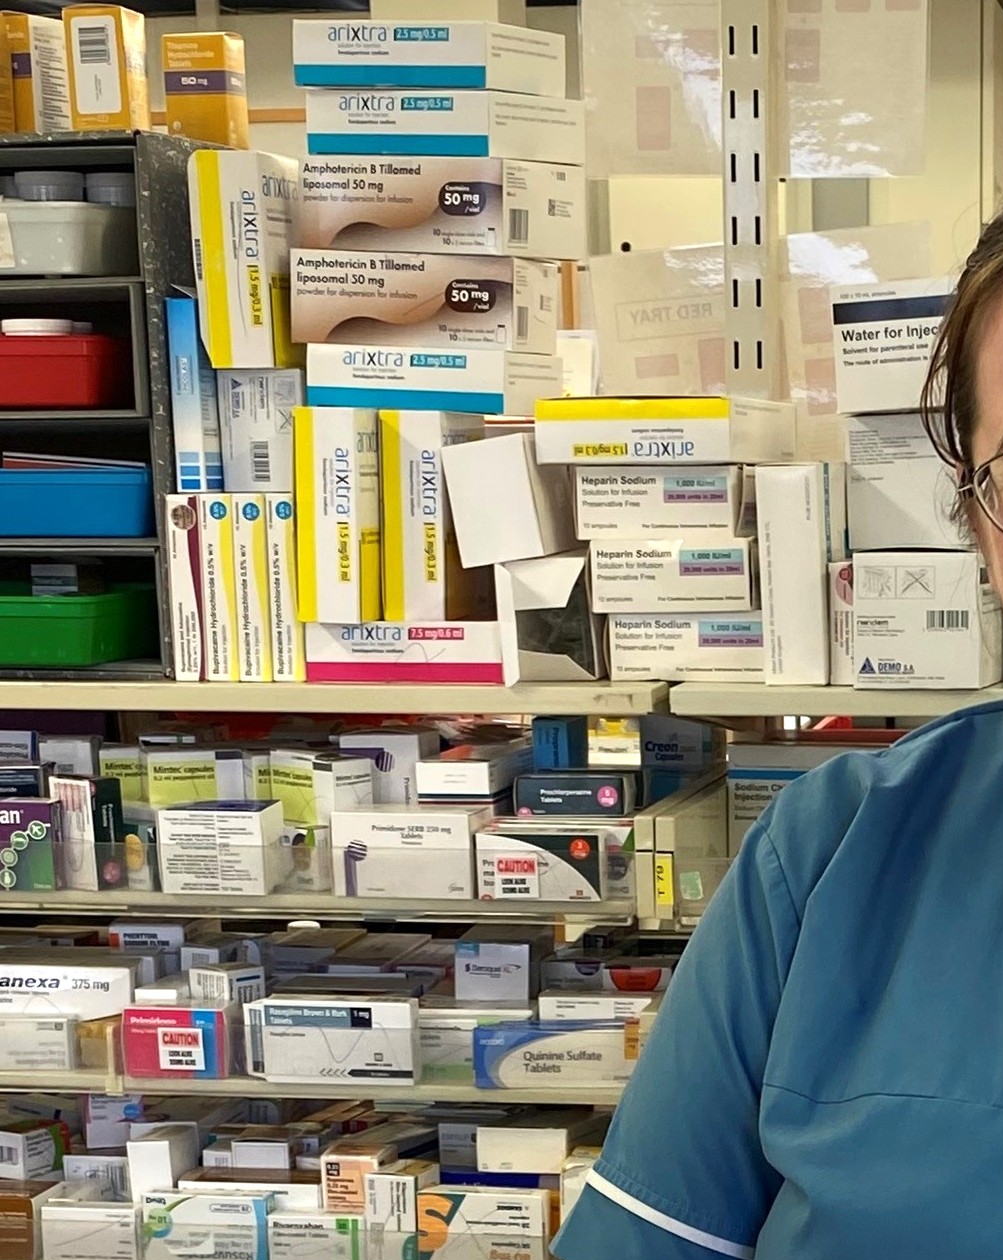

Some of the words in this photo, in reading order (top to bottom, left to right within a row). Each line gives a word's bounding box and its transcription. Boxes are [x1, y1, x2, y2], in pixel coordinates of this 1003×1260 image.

[303, 163, 367, 175] Amphotericin
[370, 165, 377, 174] B
[380, 164, 421, 175] Tillomed
[303, 179, 350, 190] liposomal
[352, 180, 365, 189] 50
[368, 181, 383, 192] mg
[444, 193, 460, 205] 50
[463, 193, 480, 204] mg
[297, 257, 367, 271] Amphotericin
[370, 260, 377, 269] B
[380, 260, 425, 272] Tillomed
[297, 273, 348, 285] liposomal
[351, 274, 365, 285] 50
[368, 277, 384, 288] mg
[841, 329, 880, 342] Water
[884, 327, 903, 339] for
[582, 477, 618, 486] Heparin
[621, 476, 656, 485] Sodium
[597, 550, 633, 559] Heparin
[636, 550, 672, 558] Sodium
[208, 577, 218, 629] Hydrochloride
[498, 860, 535, 874] CAUTION
[72, 979, 91, 990] 375
[93, 980, 110, 993] mg
[162, 1032, 199, 1047] CAUTION
[523, 1051, 564, 1063] Quinine
[567, 1050, 602, 1062] Sulfate
[524, 1063, 561, 1074] Tablets
